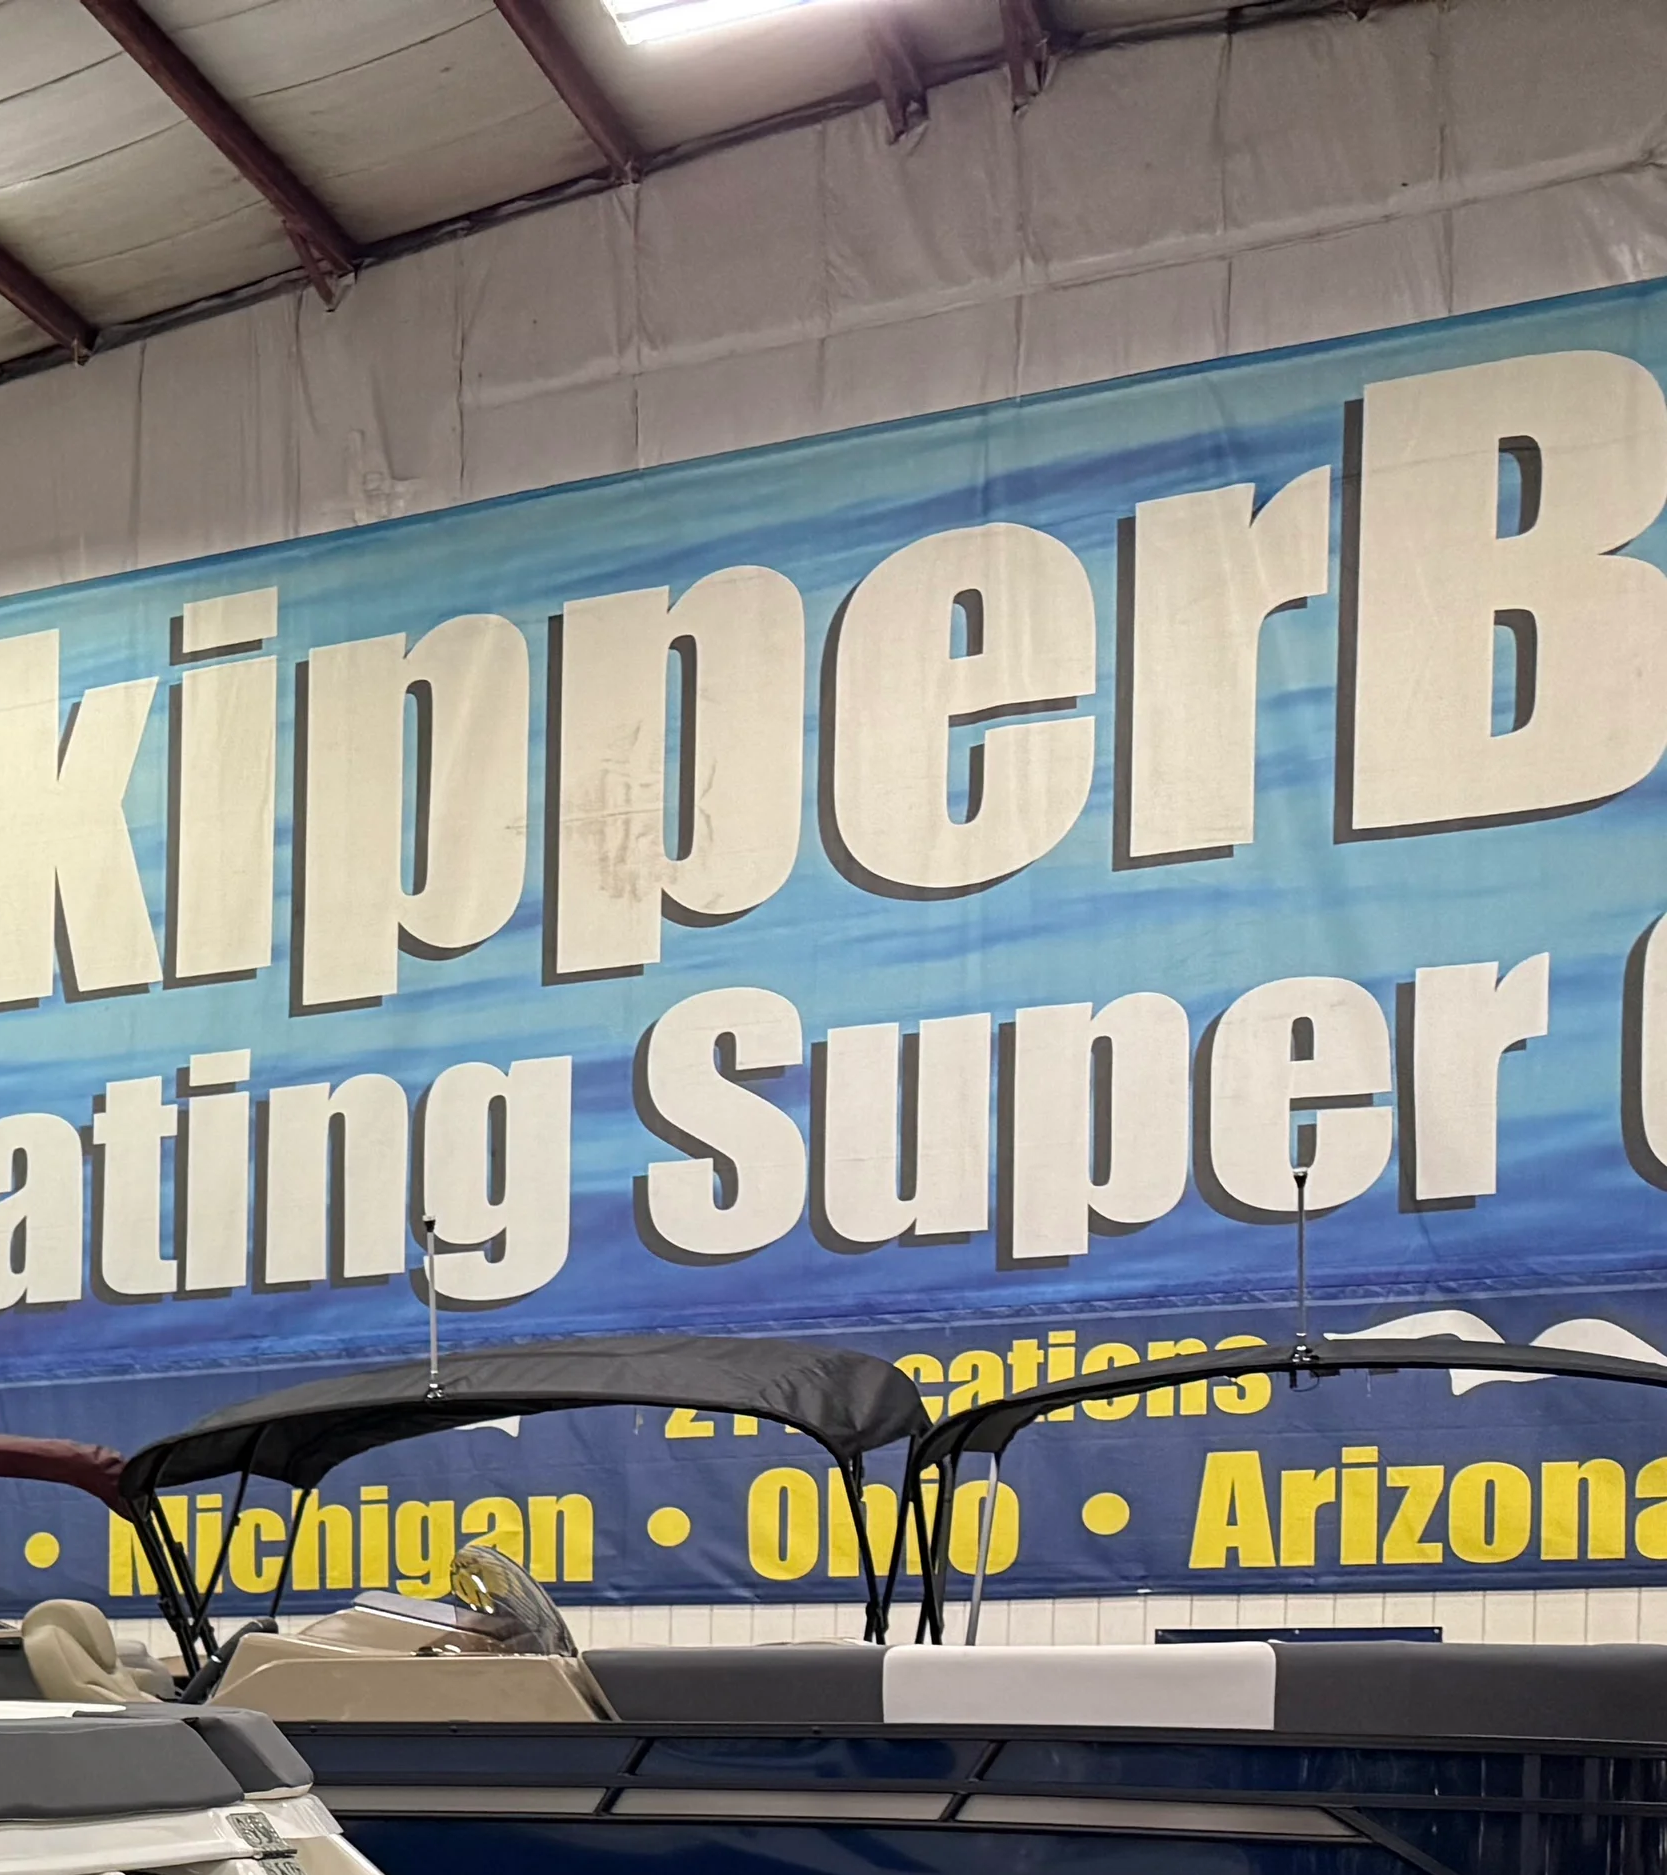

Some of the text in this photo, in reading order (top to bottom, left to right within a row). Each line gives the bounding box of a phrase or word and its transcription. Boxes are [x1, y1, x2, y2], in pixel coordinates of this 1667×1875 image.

[635, 950, 1551, 1266] Super
[108, 1485, 594, 1600] Michigan
[746, 1464, 1021, 1582] Ohio
